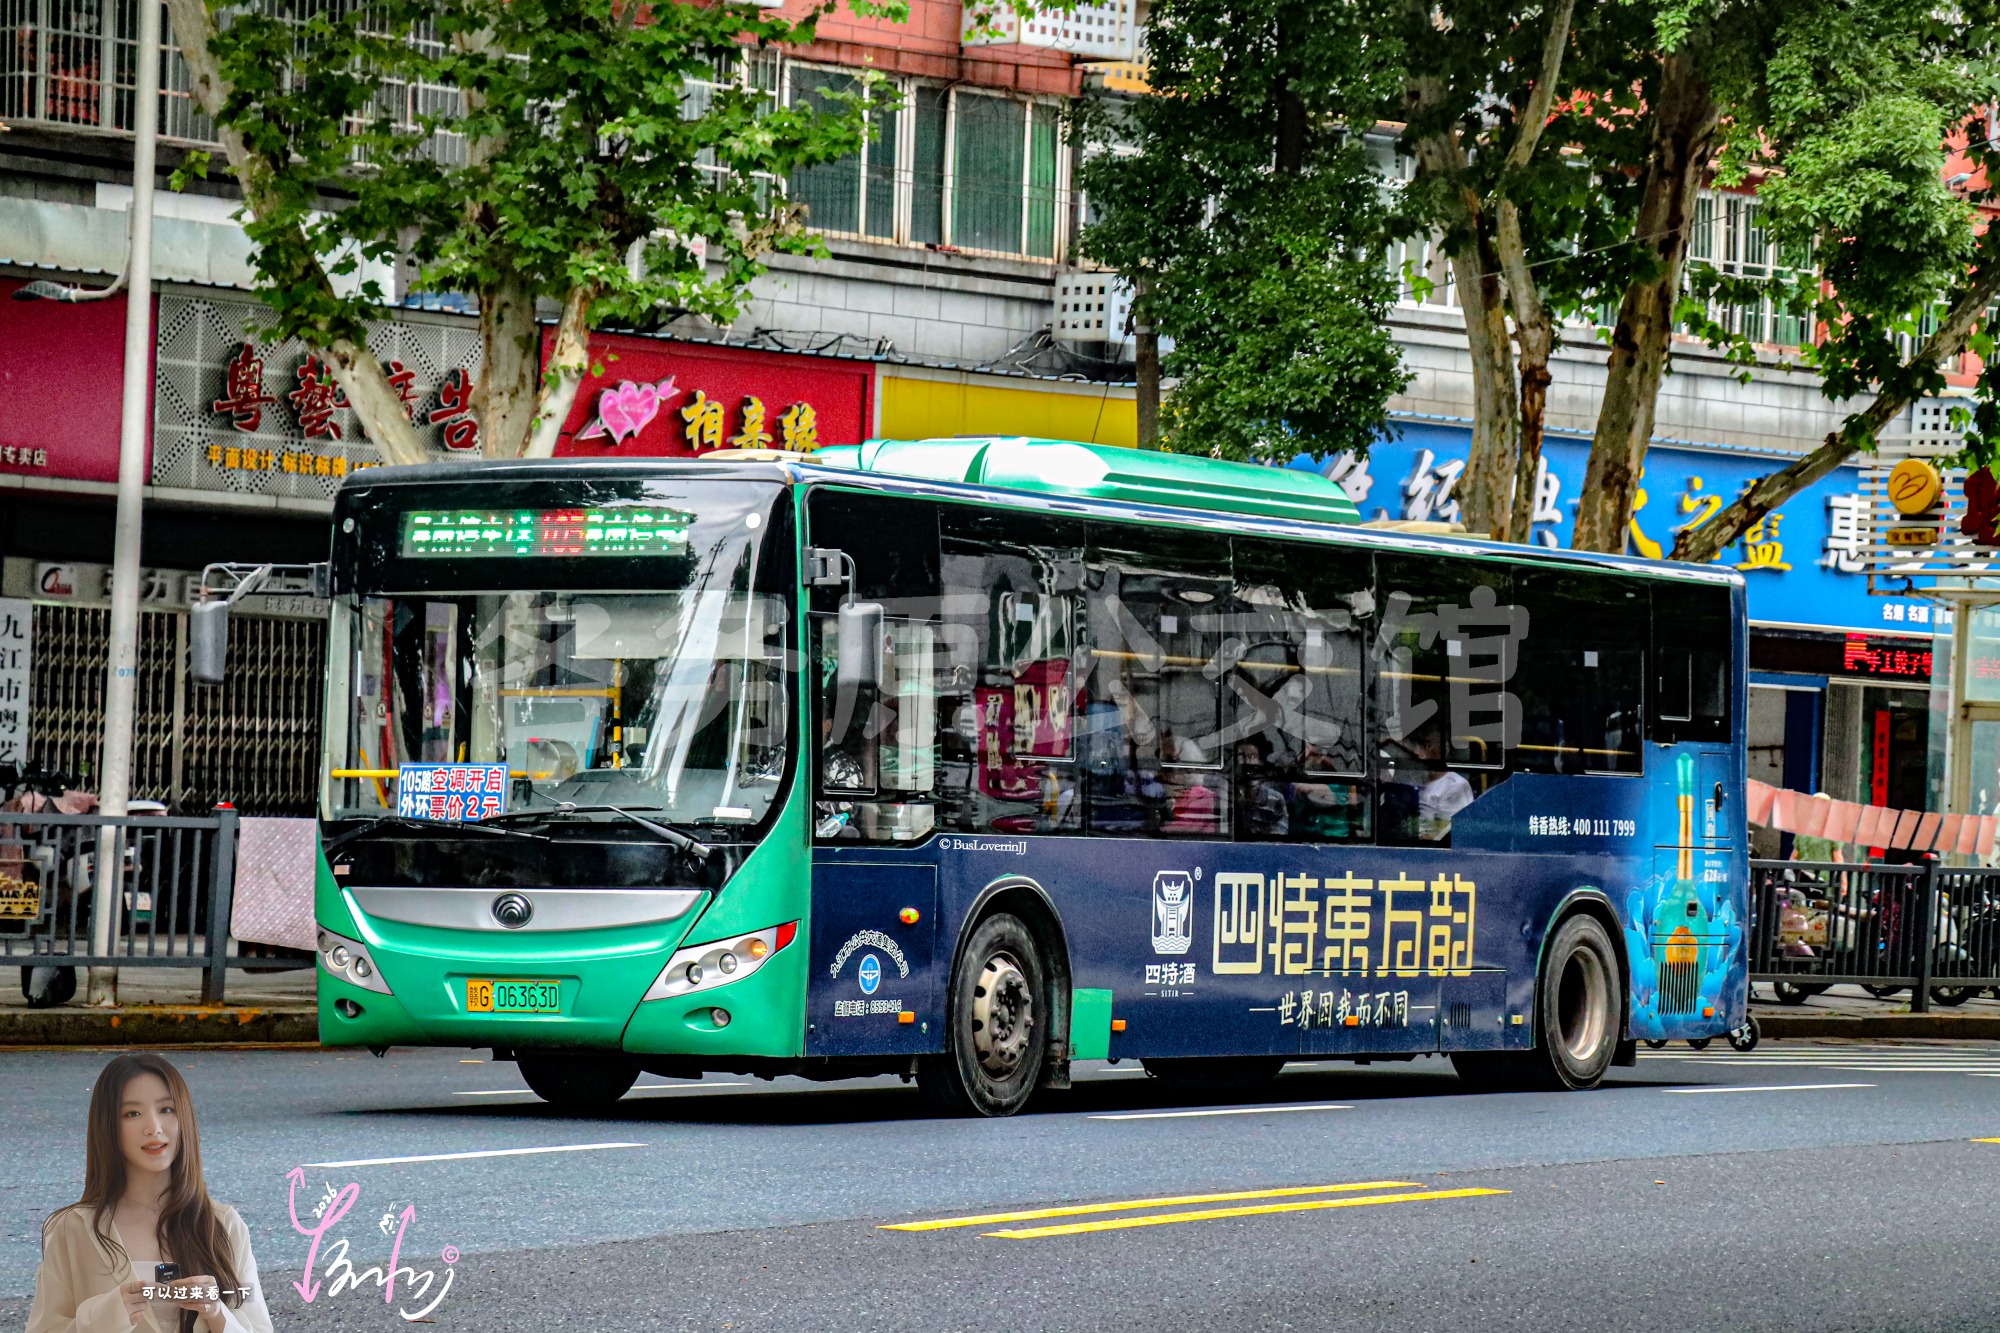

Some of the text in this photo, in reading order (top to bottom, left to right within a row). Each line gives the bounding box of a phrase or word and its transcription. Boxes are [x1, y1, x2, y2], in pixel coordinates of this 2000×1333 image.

[0, 446, 47, 467] 专卖店
[208, 445, 275, 471] 平面设计
[282, 452, 347, 478] 标识标牌
[1573, 820, 1591, 836] 400
[1593, 820, 1610, 836] 111
[1613, 820, 1636, 837] 7999
[1145, 962, 1196, 986] 四特酒
[1278, 988, 1408, 1030] 世界因我而不同
